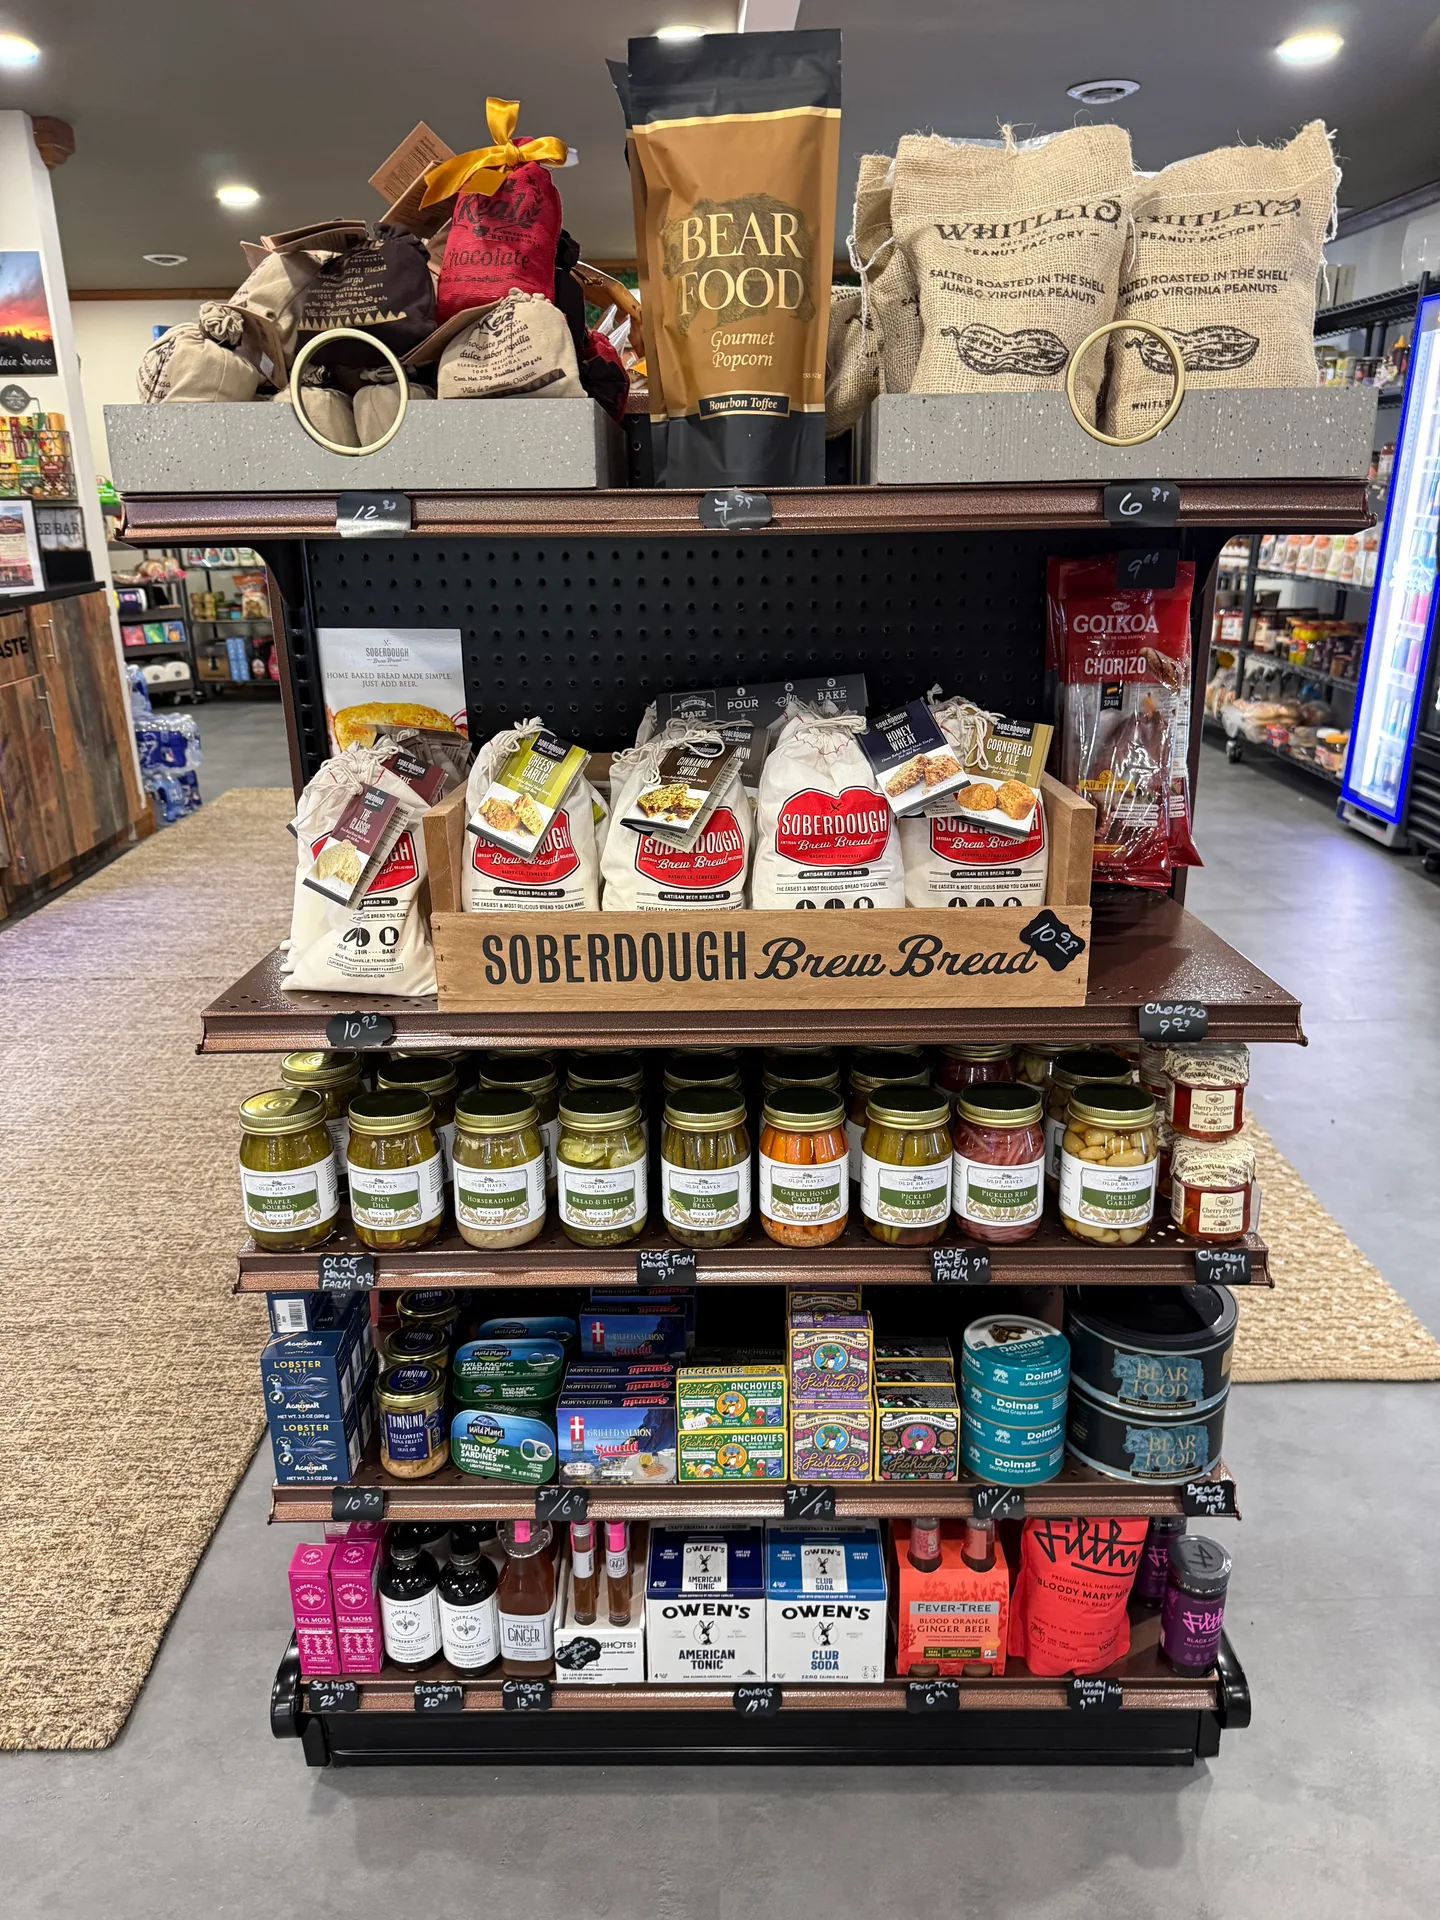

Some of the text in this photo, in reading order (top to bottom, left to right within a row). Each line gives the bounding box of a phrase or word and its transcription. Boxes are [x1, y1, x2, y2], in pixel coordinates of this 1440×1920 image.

[681, 212, 804, 264] BEAR
[1141, 223, 1265, 244] PEANUT FACTORY
[1022, 230, 1084, 253] FACTORY
[929, 269, 1105, 295] SALTED ROASTED IN THE SHELL
[1151, 268, 1288, 284] ROASTED IN THE SHELL
[680, 267, 804, 316] FOOD
[940, 281, 1096, 305] JUMBO VIRGINIA PEANUTS
[1122, 283, 1278, 308] JUMBO VIRGINIA PEANUTS
[710, 330, 775, 353] Gourmet
[712, 351, 773, 372] Popcorn
[709, 397, 778, 412] Bourbon Toffee
[1119, 492, 1143, 516] 6
[54, 522, 80, 535] BAR
[1072, 614, 1159, 633] GOIKOA
[365, 647, 409, 658] SOBERDOUGH
[1084, 656, 1147, 675] CHORIZO
[362, 680, 378, 688] JUST
[381, 680, 398, 688] ADD
[817, 689, 847, 701] BAKE
[727, 699, 759, 710] POUR
[885, 724, 911, 742] HONEY
[537, 738, 567, 756] SOBERDOUGH
[889, 733, 917, 752] WHEAT
[986, 738, 1033, 757] CORNBREAD
[527, 754, 557, 773] CHEESY
[676, 756, 713, 769] CINNAMON
[994, 752, 1019, 767] & ALE
[521, 766, 549, 786] GARLIC
[677, 766, 700, 778] SWIRL
[360, 808, 373, 822] THE
[348, 817, 371, 836] CLASSIC
[781, 809, 887, 836] SOBERDOUGH
[797, 834, 873, 851] Brew Bread
[656, 853, 728, 870] Brew Bread
[1030, 923, 1056, 942] 10
[482, 931, 1038, 985] SOBERDOUGH Brew Bread
[343, 1021, 358, 1040] 10
[1192, 1104, 1212, 1112] Cherry
[467, 1196, 516, 1205] HORSERADISH
[572, 1196, 628, 1205] BREAD BUTTER
[780, 1189, 832, 1198] GARLIC HONEY
[981, 1190, 1013, 1198] PICKLED
[372, 1201, 390, 1209] DILL
[1202, 1206, 1221, 1214] Cherry
[936, 1269, 968, 1282] FARM
[1209, 1267, 1222, 1280] 15
[322, 1279, 351, 1290] FARM
[274, 1360, 321, 1369] LOBSTER
[1025, 1366, 1062, 1382] Dolmas
[1136, 1366, 1188, 1382] BEAR
[730, 1381, 783, 1391] ANCHOVIES
[1133, 1380, 1189, 1399] FOOD
[996, 1400, 1040, 1411] Dolmas
[283, 1424, 329, 1432] LOBSTER
[387, 1414, 424, 1429] TONNINO
[469, 1425, 504, 1438] Wild Planet
[586, 1428, 620, 1437] GRILLED
[731, 1434, 783, 1442] ANCHOVIES
[461, 1443, 510, 1457] WILD PACIFIC
[1149, 1435, 1197, 1451] BEAR
[460, 1450, 497, 1462] SARDINES
[994, 1459, 1037, 1469] Dolmas
[344, 1496, 360, 1511] 10
[685, 1545, 726, 1554] OWEN'S
[804, 1548, 841, 1557] OWEN'S
[688, 1576, 722, 1584] AMERICAN
[1037, 1577, 1079, 1596] BLOODY
[1082, 1590, 1112, 1600] MARY
[661, 1603, 751, 1620] OWEN'S
[781, 1604, 871, 1621] OWEN'S
[917, 1603, 992, 1613] FEVER-TREE
[507, 1629, 540, 1643] GINGER
[917, 1625, 991, 1633] GINGER BEER
[600, 1641, 637, 1650] SHOTS!
[678, 1649, 736, 1660] AMERICAN
[811, 1650, 839, 1660] CLUB
[690, 1660, 724, 1670] TONIC
[810, 1660, 839, 1671] SODA
[423, 1697, 439, 1708] 20
[516, 1696, 529, 1708] 12
[925, 1693, 935, 1705] 6
